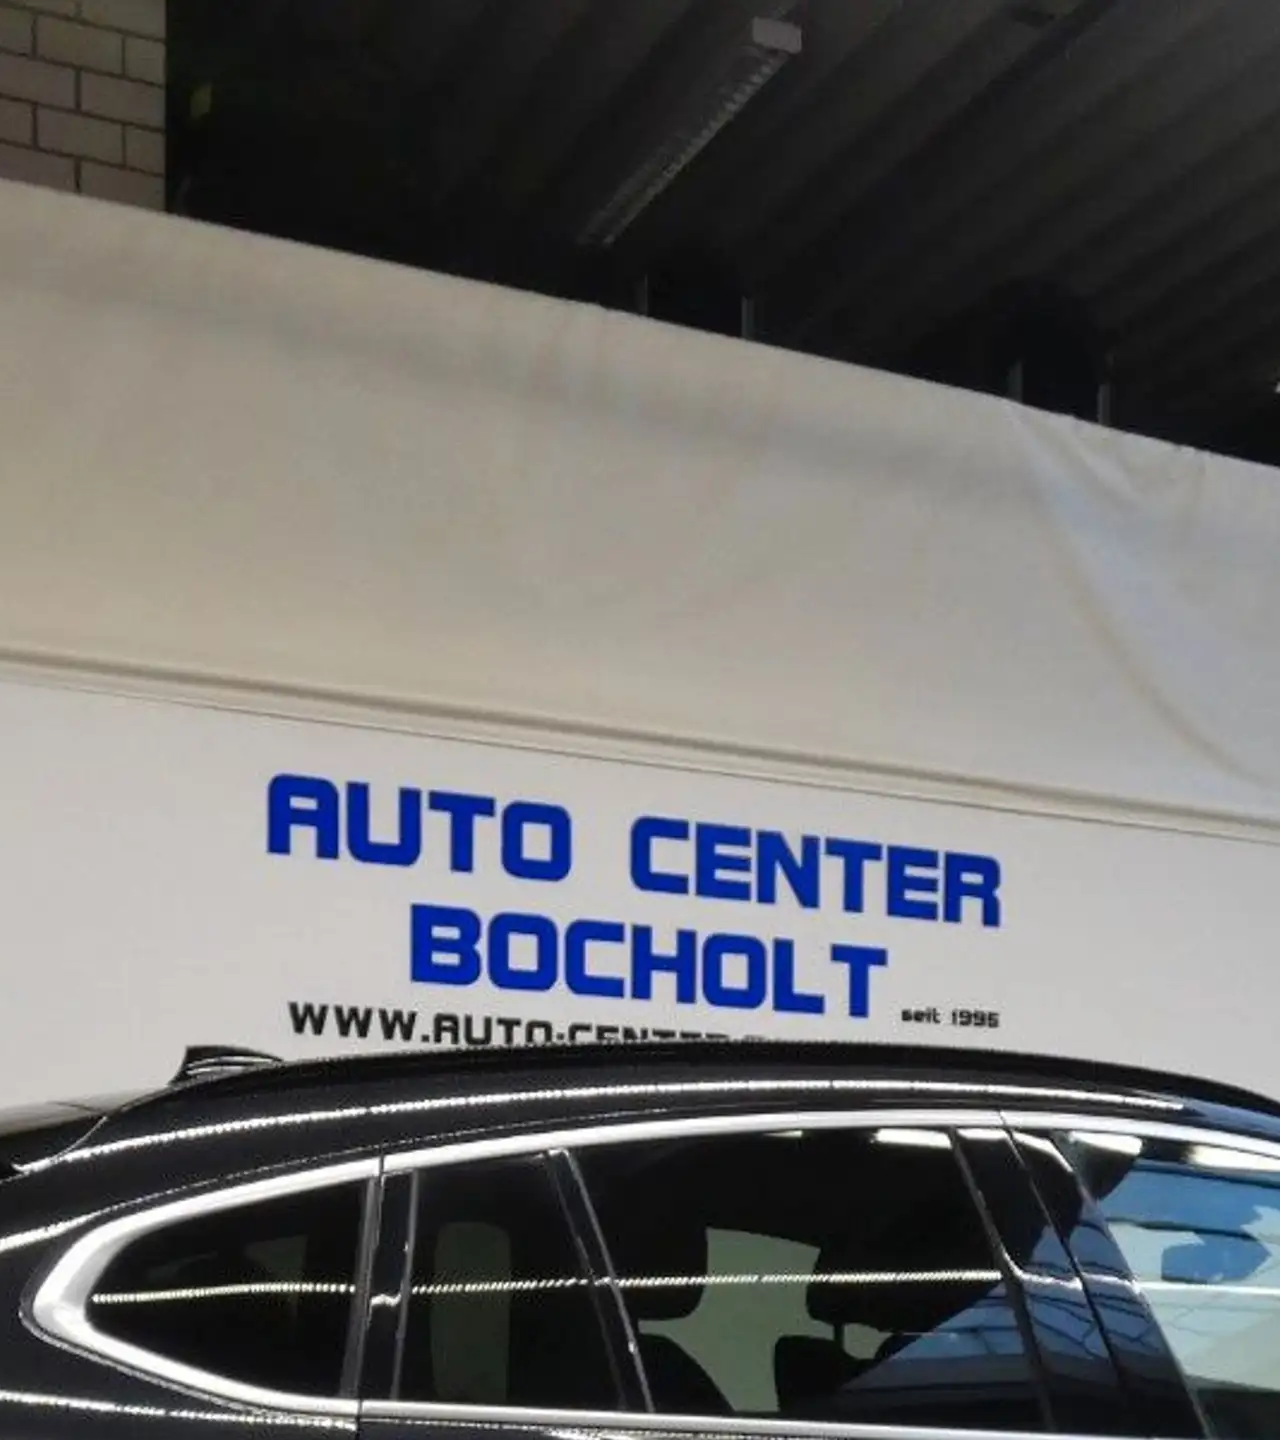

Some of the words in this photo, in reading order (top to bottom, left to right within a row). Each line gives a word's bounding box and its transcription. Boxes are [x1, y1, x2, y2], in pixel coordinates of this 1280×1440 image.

[266, 773, 575, 882] AUTO
[629, 816, 1003, 929] CENTER
[409, 902, 889, 1020] BOCHOLT
